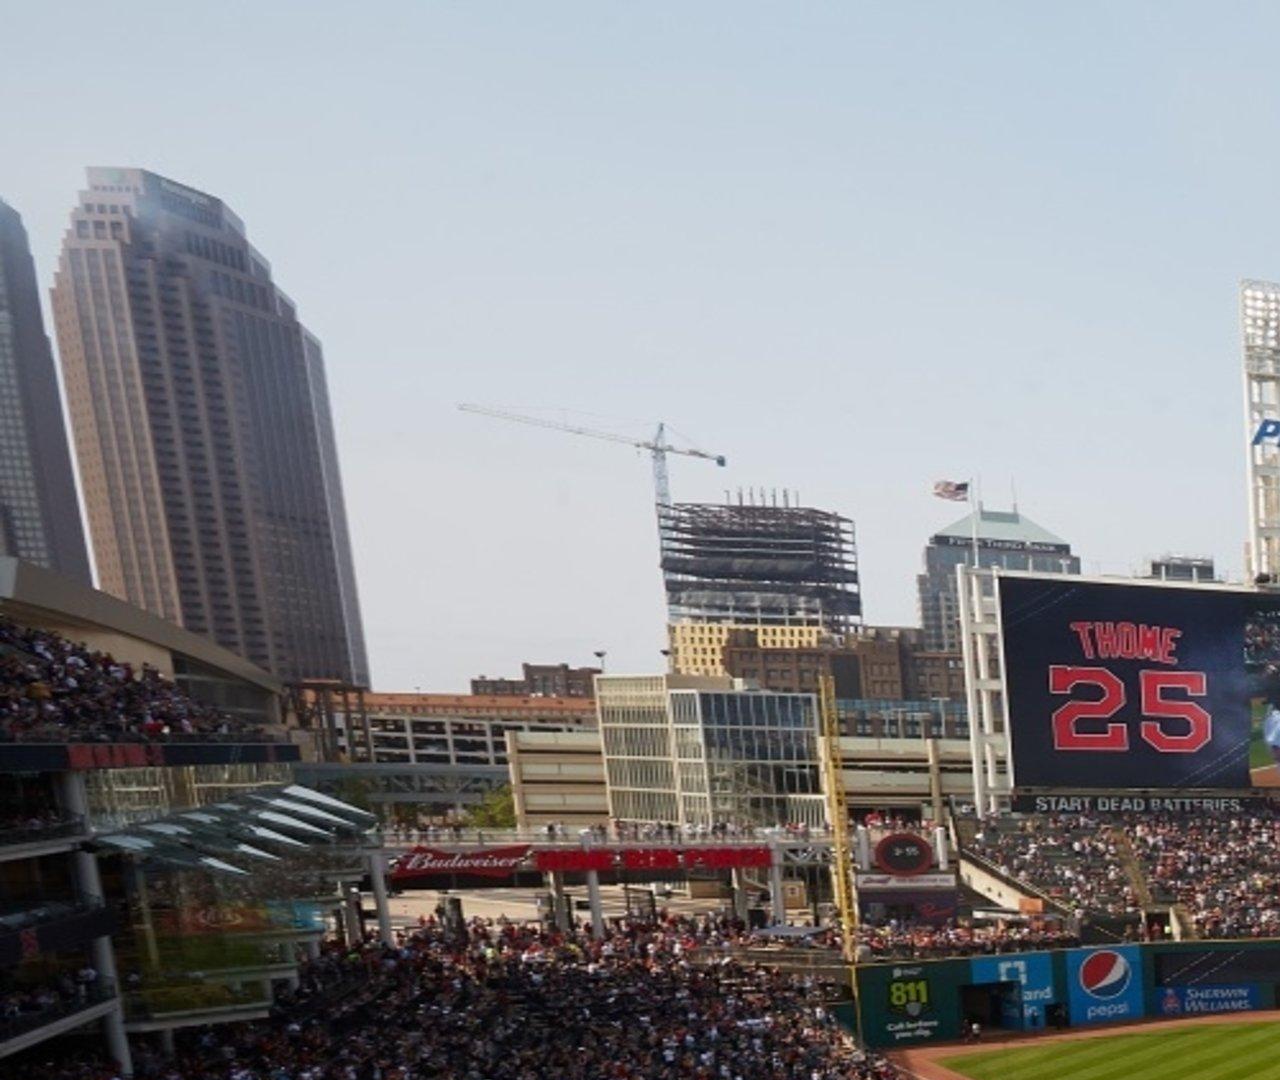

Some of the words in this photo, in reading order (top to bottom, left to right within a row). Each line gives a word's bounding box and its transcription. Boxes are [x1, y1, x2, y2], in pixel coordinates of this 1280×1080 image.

[1070, 621, 1183, 665] THOME
[1049, 664, 1212, 752] 25
[1036, 797, 1089, 812] START
[1098, 797, 1145, 812] DEAD
[405, 852, 519, 871] Budweiser
[890, 980, 928, 1006] 811
[1086, 1003, 1128, 1020] pepsi
